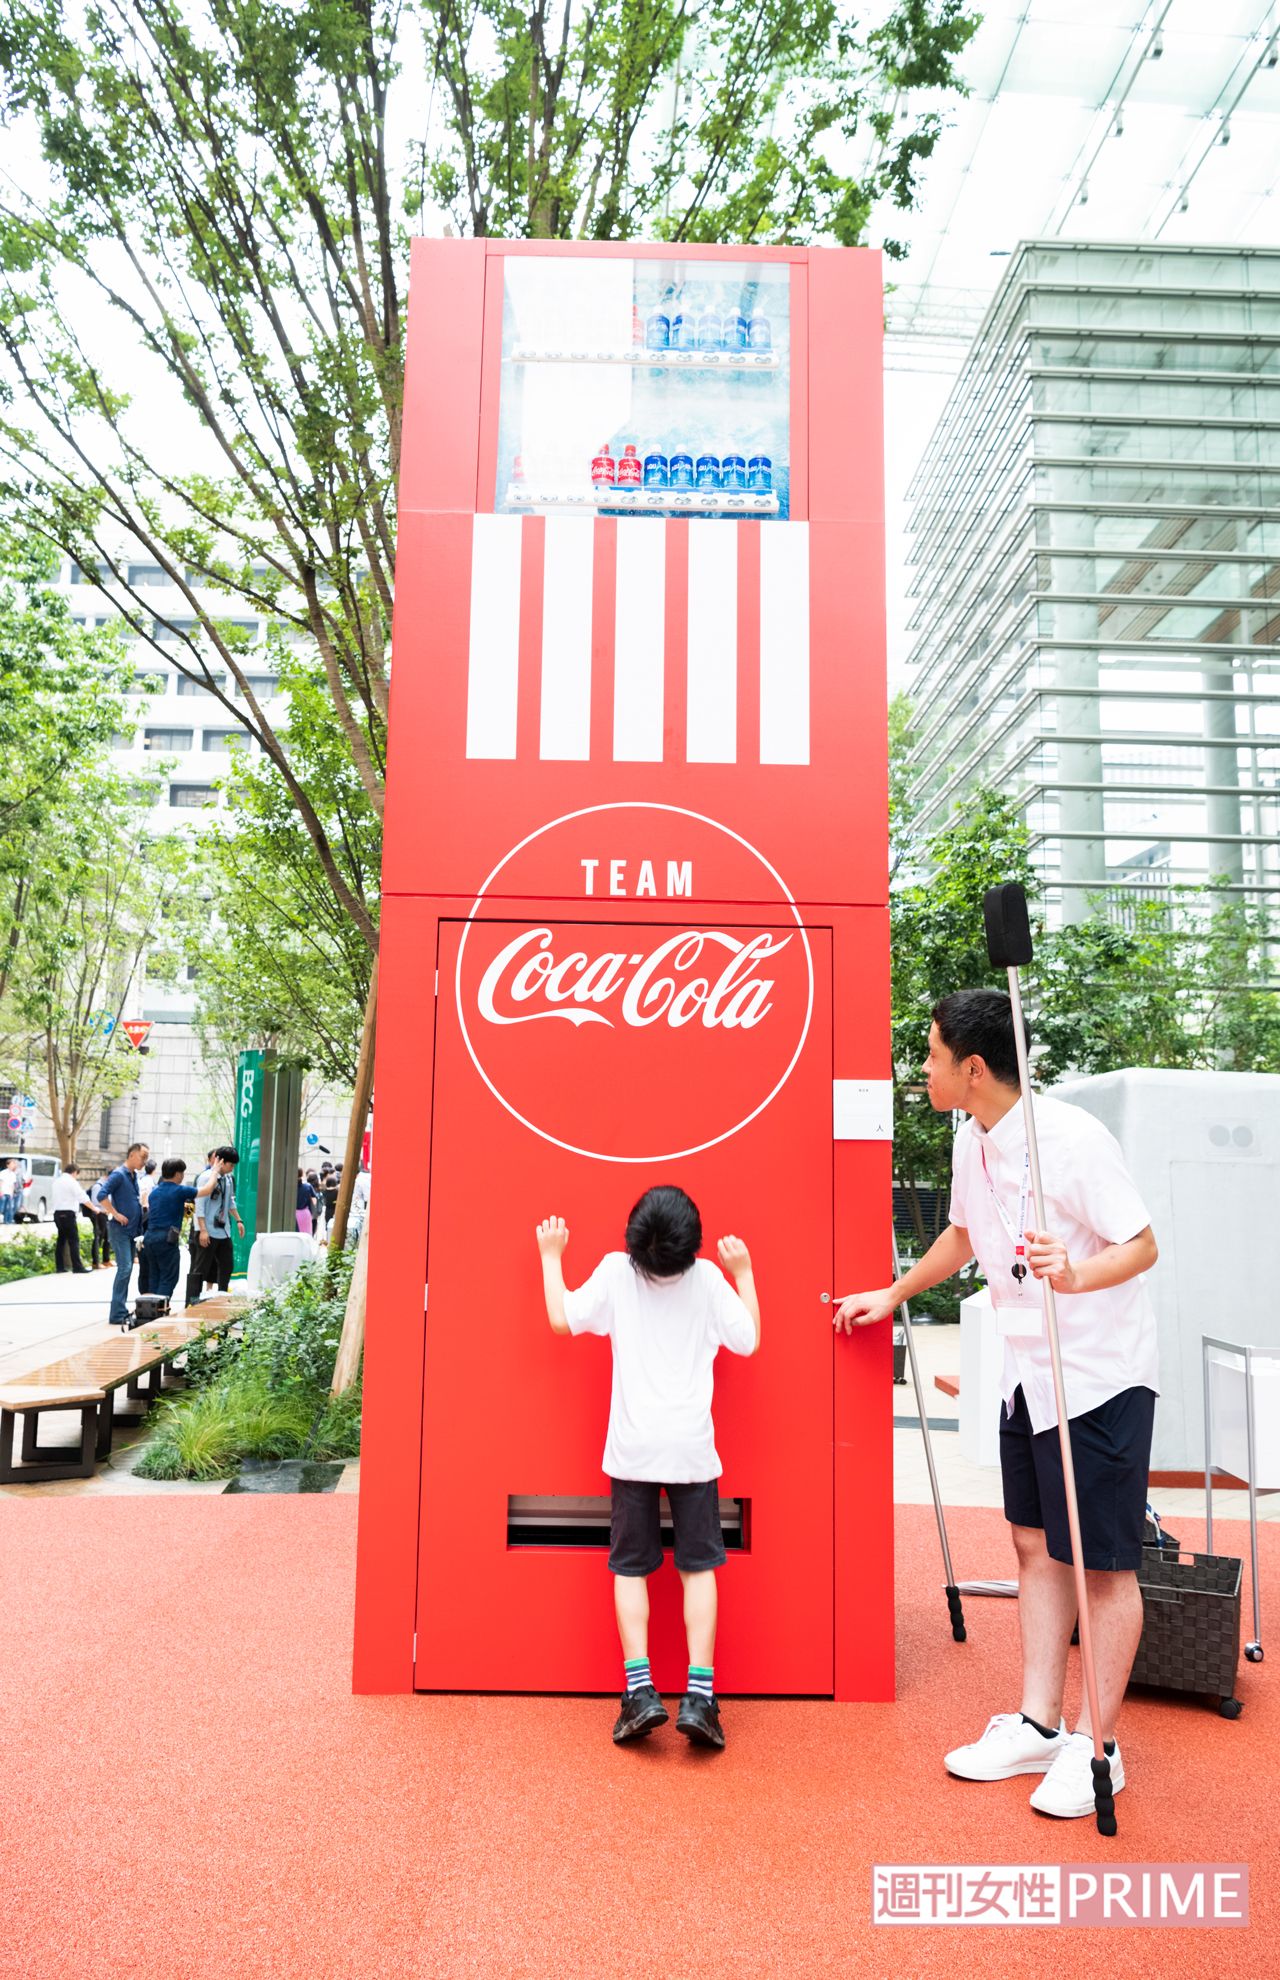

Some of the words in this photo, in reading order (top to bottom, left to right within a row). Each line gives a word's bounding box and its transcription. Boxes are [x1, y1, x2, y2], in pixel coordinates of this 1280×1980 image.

[581, 859, 693, 897] TEAM
[478, 928, 793, 1029] Coca-Cola
[240, 1069, 255, 1118] BCG
